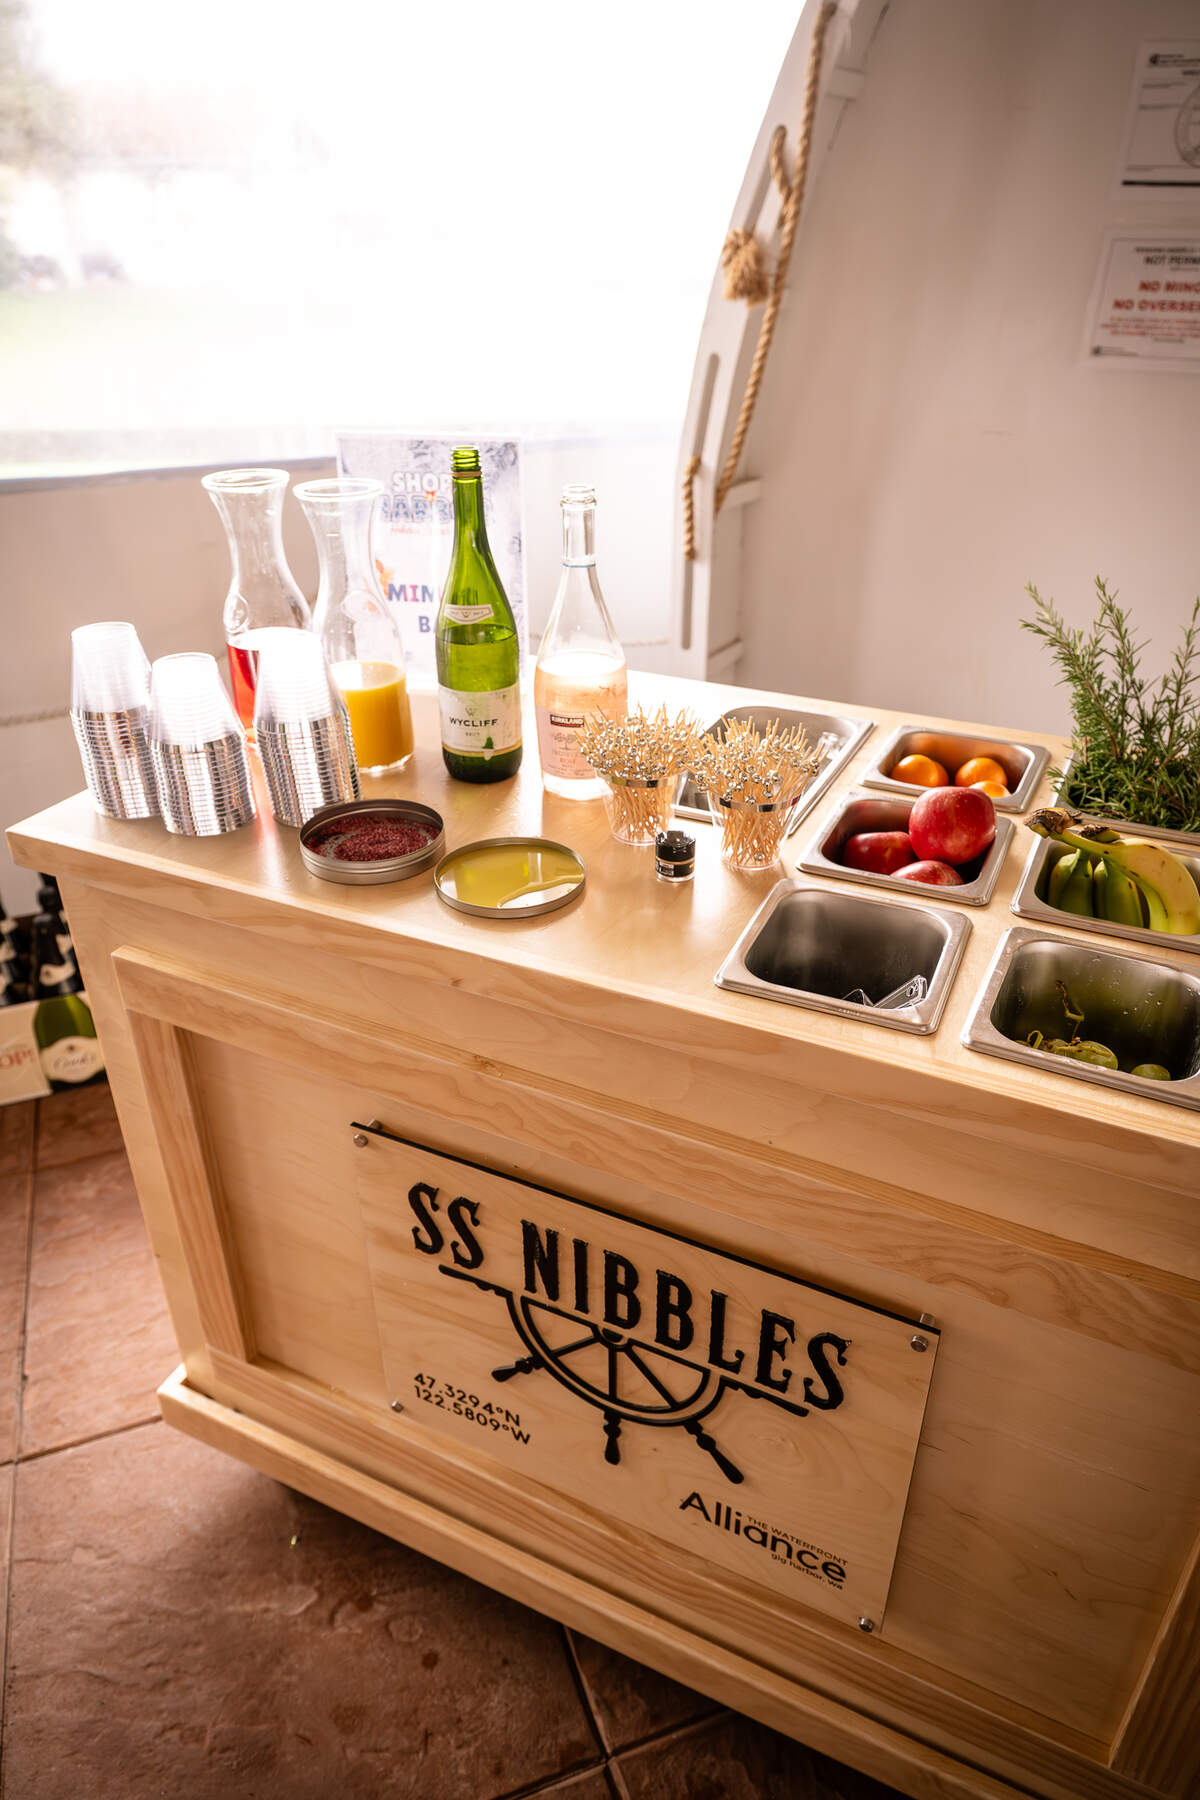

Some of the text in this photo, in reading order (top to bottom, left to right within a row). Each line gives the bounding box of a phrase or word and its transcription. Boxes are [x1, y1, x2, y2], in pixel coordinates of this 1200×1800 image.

[1139, 281, 1161, 292] NO
[1112, 299, 1134, 311] NO
[449, 717, 498, 728] WYCLIFF
[408, 1182, 853, 1411] SS NIBBLES
[679, 1491, 847, 1583] Alliance
[747, 1515, 849, 1567] THE WATERFRONT
[771, 1553, 787, 1565] gig
